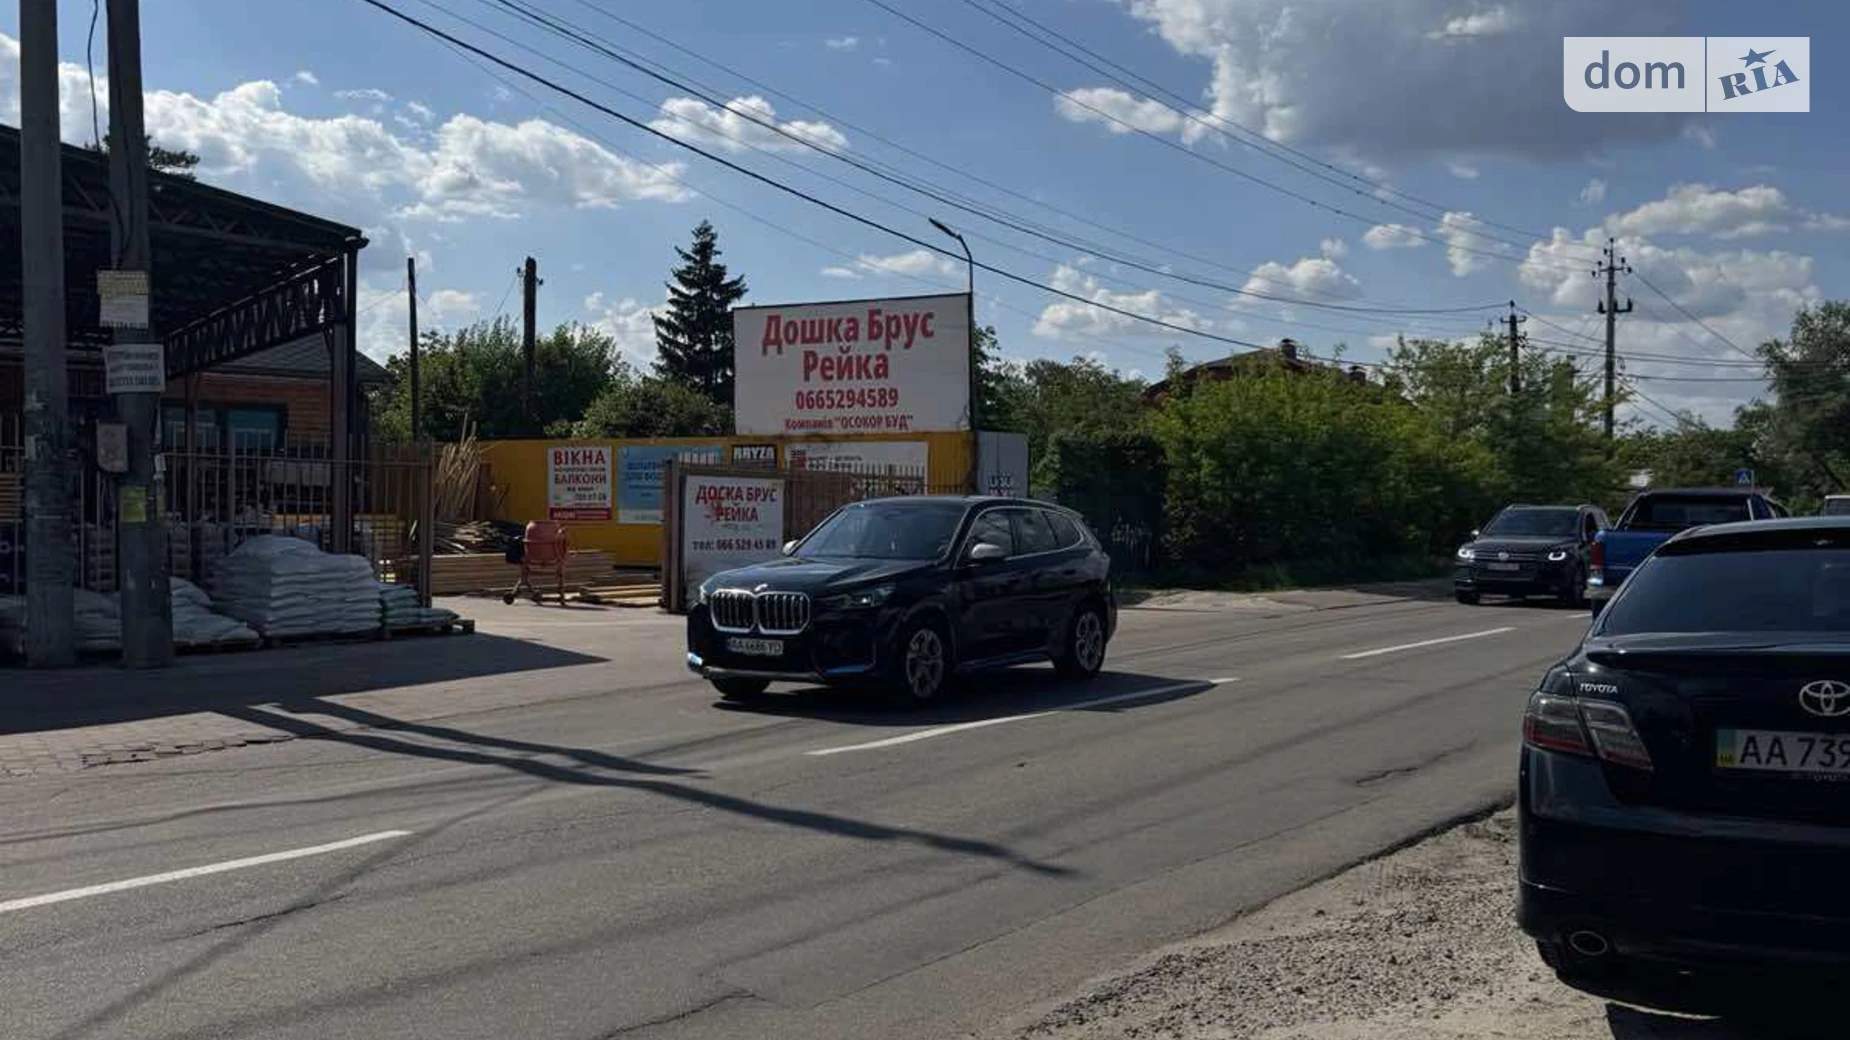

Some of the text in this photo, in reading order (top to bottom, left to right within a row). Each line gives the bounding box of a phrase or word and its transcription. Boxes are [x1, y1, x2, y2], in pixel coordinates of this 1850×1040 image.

[762, 308, 935, 355] Дошка Брус
[803, 345, 889, 382] Рейка
[795, 388, 899, 410] 0665294589
[554, 449, 606, 466] ВІКНА
[554, 473, 607, 485] БАЛКОНИ
[695, 485, 777, 505] ДОСКА БРУС
[715, 502, 758, 521] РЕЙКА
[1580, 683, 1618, 694] TOYOTA
[1740, 735, 1788, 766] AA
